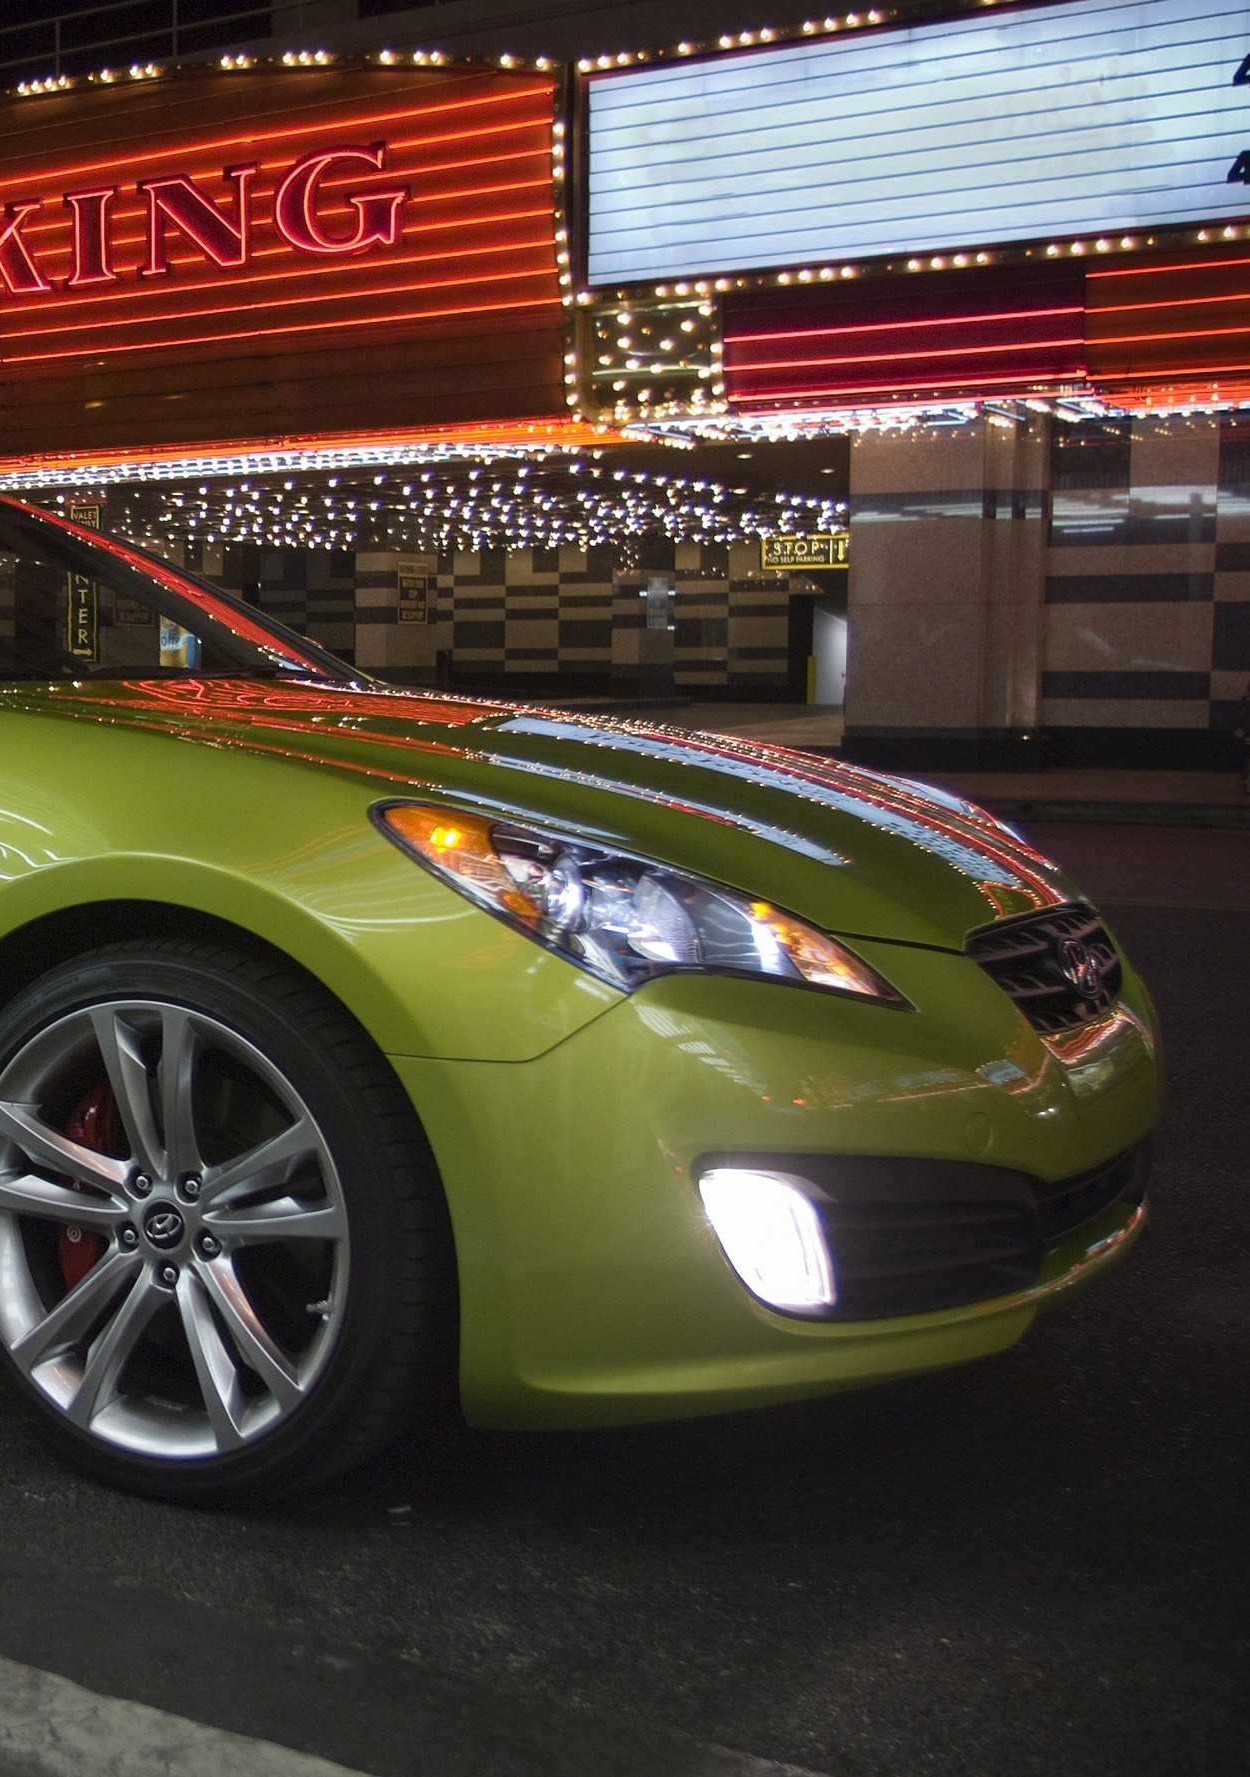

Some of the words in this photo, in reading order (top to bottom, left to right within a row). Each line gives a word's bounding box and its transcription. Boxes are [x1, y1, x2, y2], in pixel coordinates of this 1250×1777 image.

[73, 511, 96, 520] VALET
[773, 541, 819, 555] STOP
[767, 556, 779, 564] NO
[796, 555, 825, 563] PARKING
[76, 574, 88, 644] NTER
